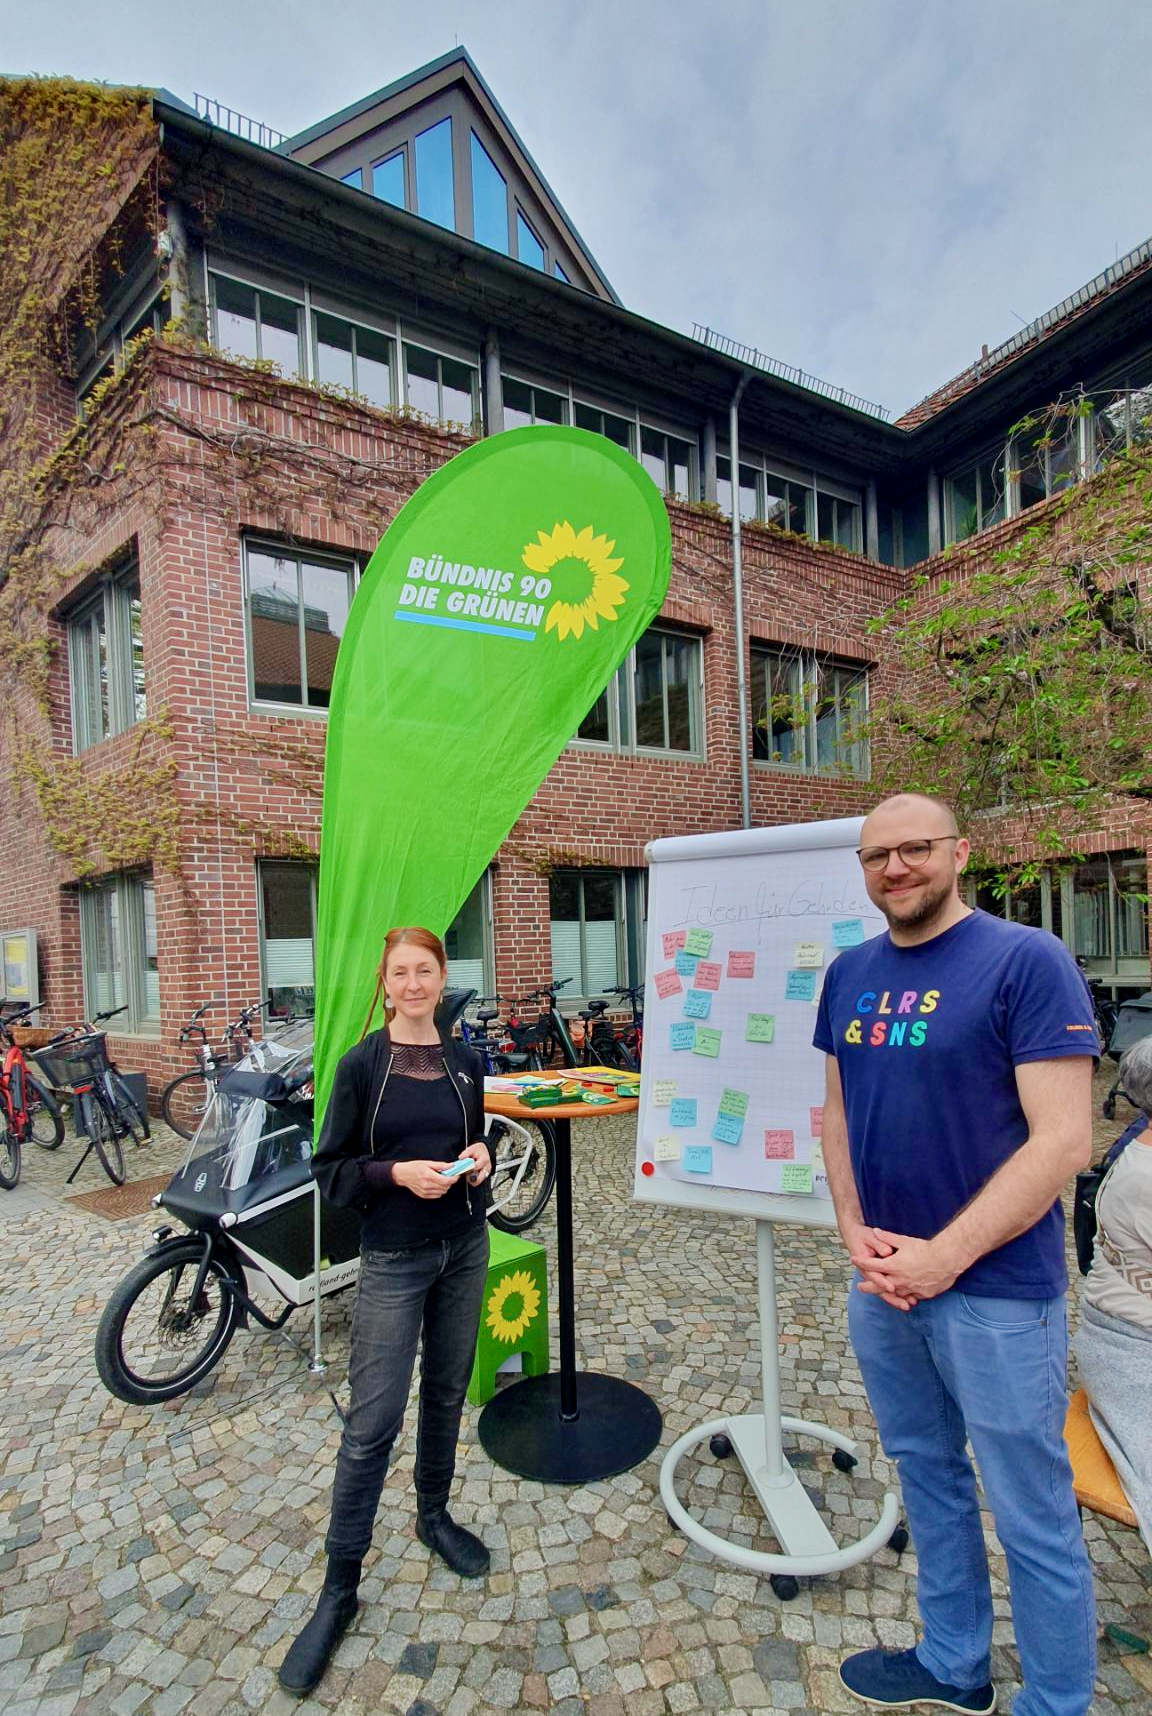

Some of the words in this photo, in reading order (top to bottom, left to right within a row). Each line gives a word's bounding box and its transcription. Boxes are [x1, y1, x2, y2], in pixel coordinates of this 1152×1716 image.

[407, 553, 514, 593] BÜNDNIS
[520, 575, 552, 600] 90
[398, 583, 441, 610] DIE
[446, 590, 545, 627] GRÜNEN
[674, 884, 748, 926] Ideen
[856, 989, 941, 1015] CLRS
[844, 1019, 862, 1044] &
[869, 1020, 927, 1047] SNS
